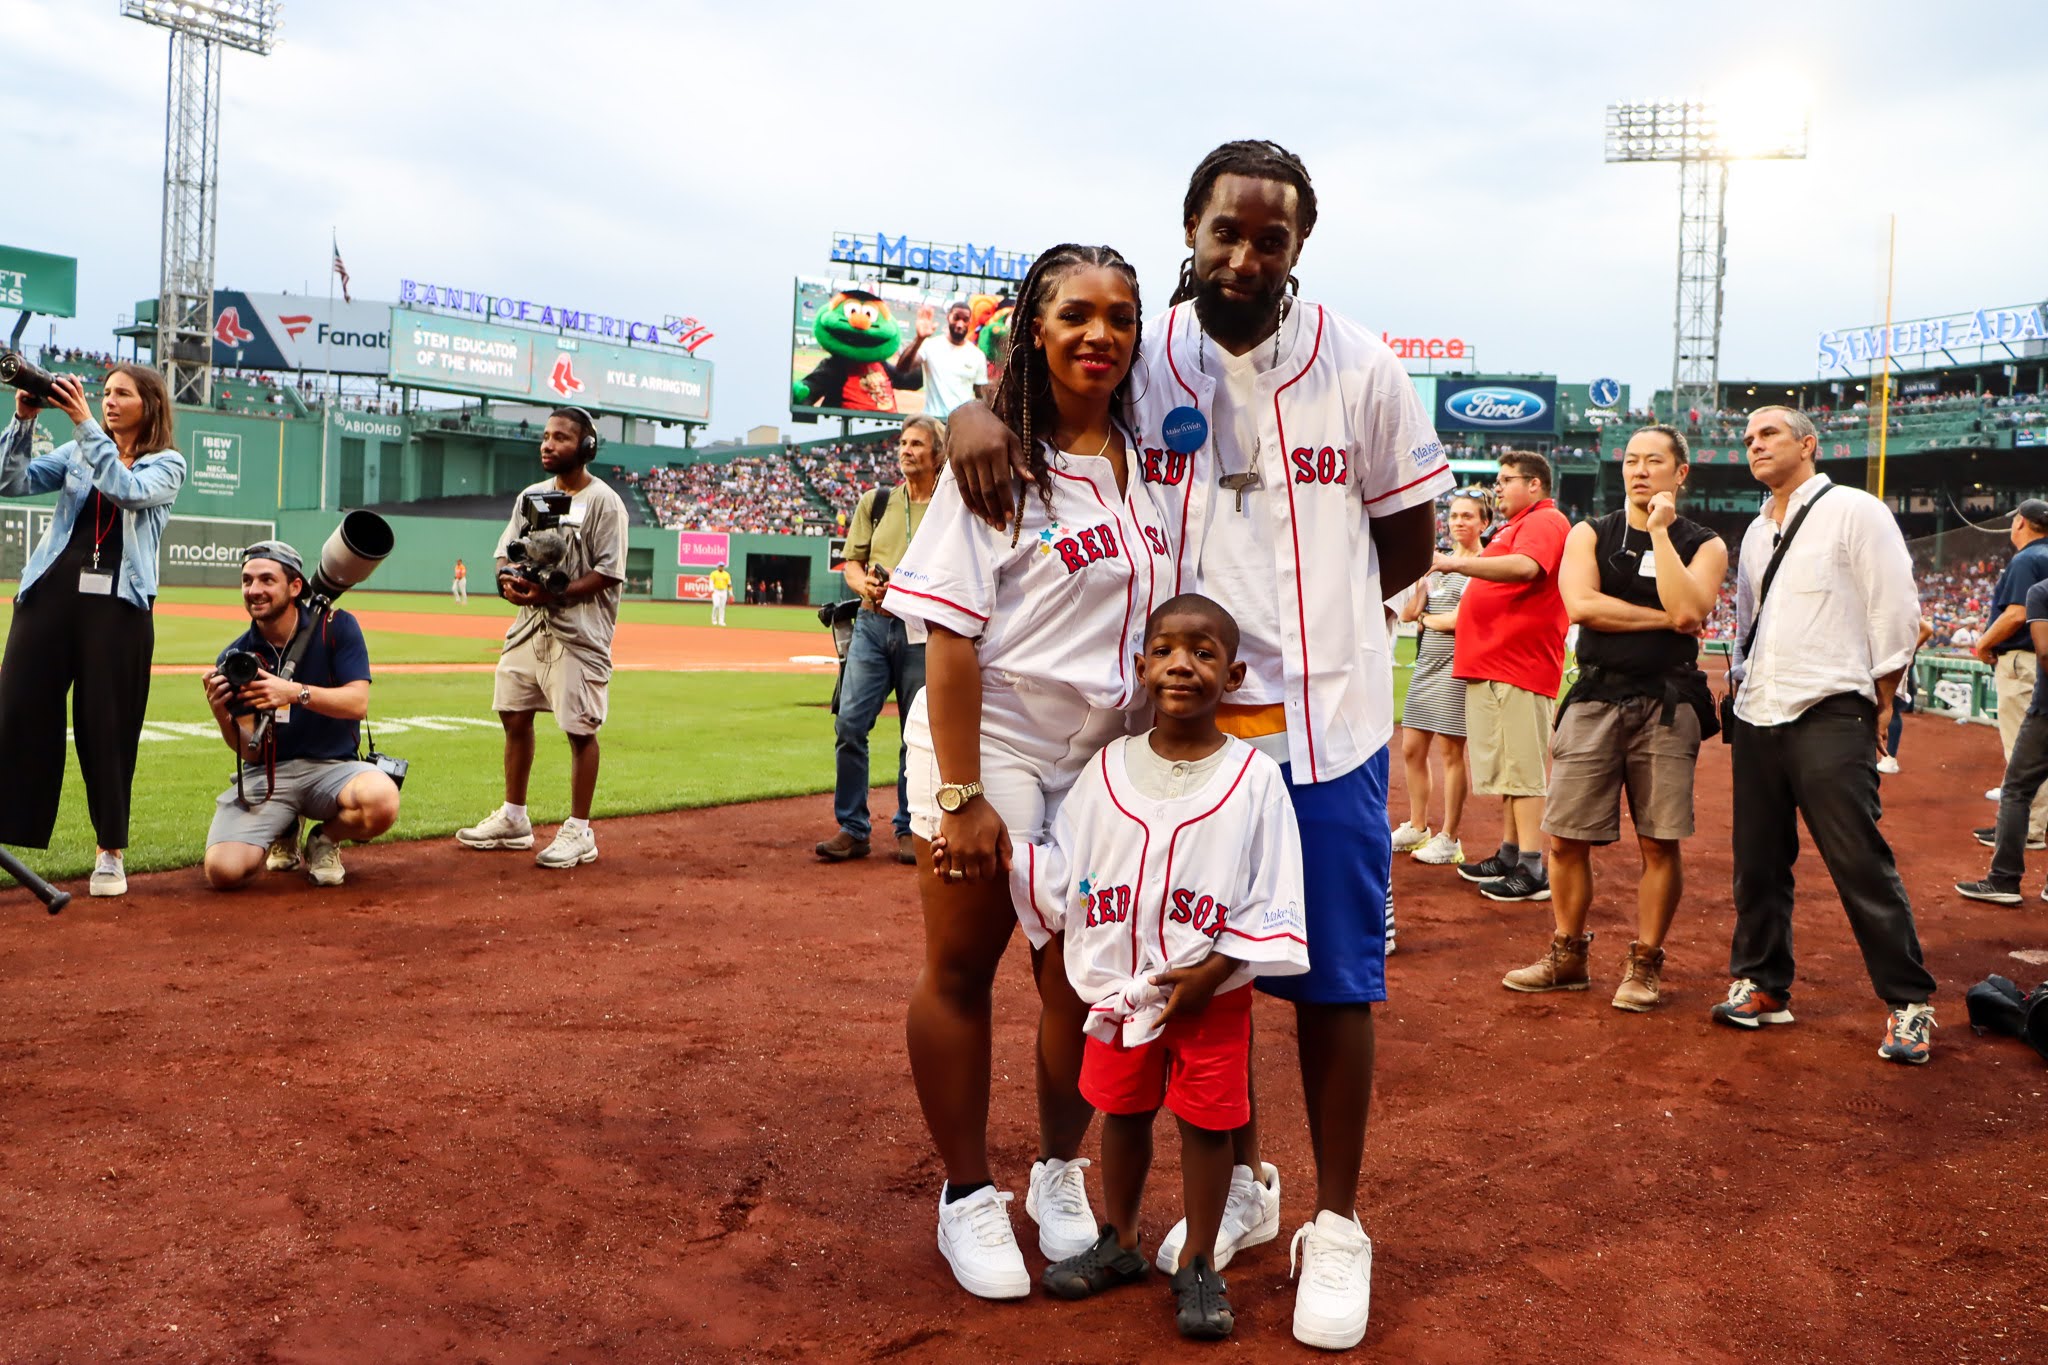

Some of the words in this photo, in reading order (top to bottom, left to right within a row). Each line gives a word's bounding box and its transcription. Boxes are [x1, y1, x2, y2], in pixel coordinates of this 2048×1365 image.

[401, 279, 485, 315] BANK
[495, 297, 532, 320] OF
[540, 305, 660, 344] AMERICA
[413, 330, 450, 350] STEM
[452, 336, 518, 360] EDUCATOR
[1817, 318, 1954, 371] SAMUEL
[1964, 306, 2048, 342] ADA
[416, 350, 436, 366] OF
[440, 353, 466, 371] THE
[469, 357, 514, 377] MONTH
[606, 369, 637, 388] KYLE
[640, 375, 701, 398] ARRINGTON
[1465, 391, 1526, 419] Ford
[344, 419, 402, 437] ABIOMED
[202, 436, 232, 449] IBEW
[208, 448, 227, 460] 103
[1833, 443, 1851, 458] 34
[693, 543, 726, 556] Mobile
[1053, 523, 1119, 574] RED
[1085, 884, 1132, 928] RED
